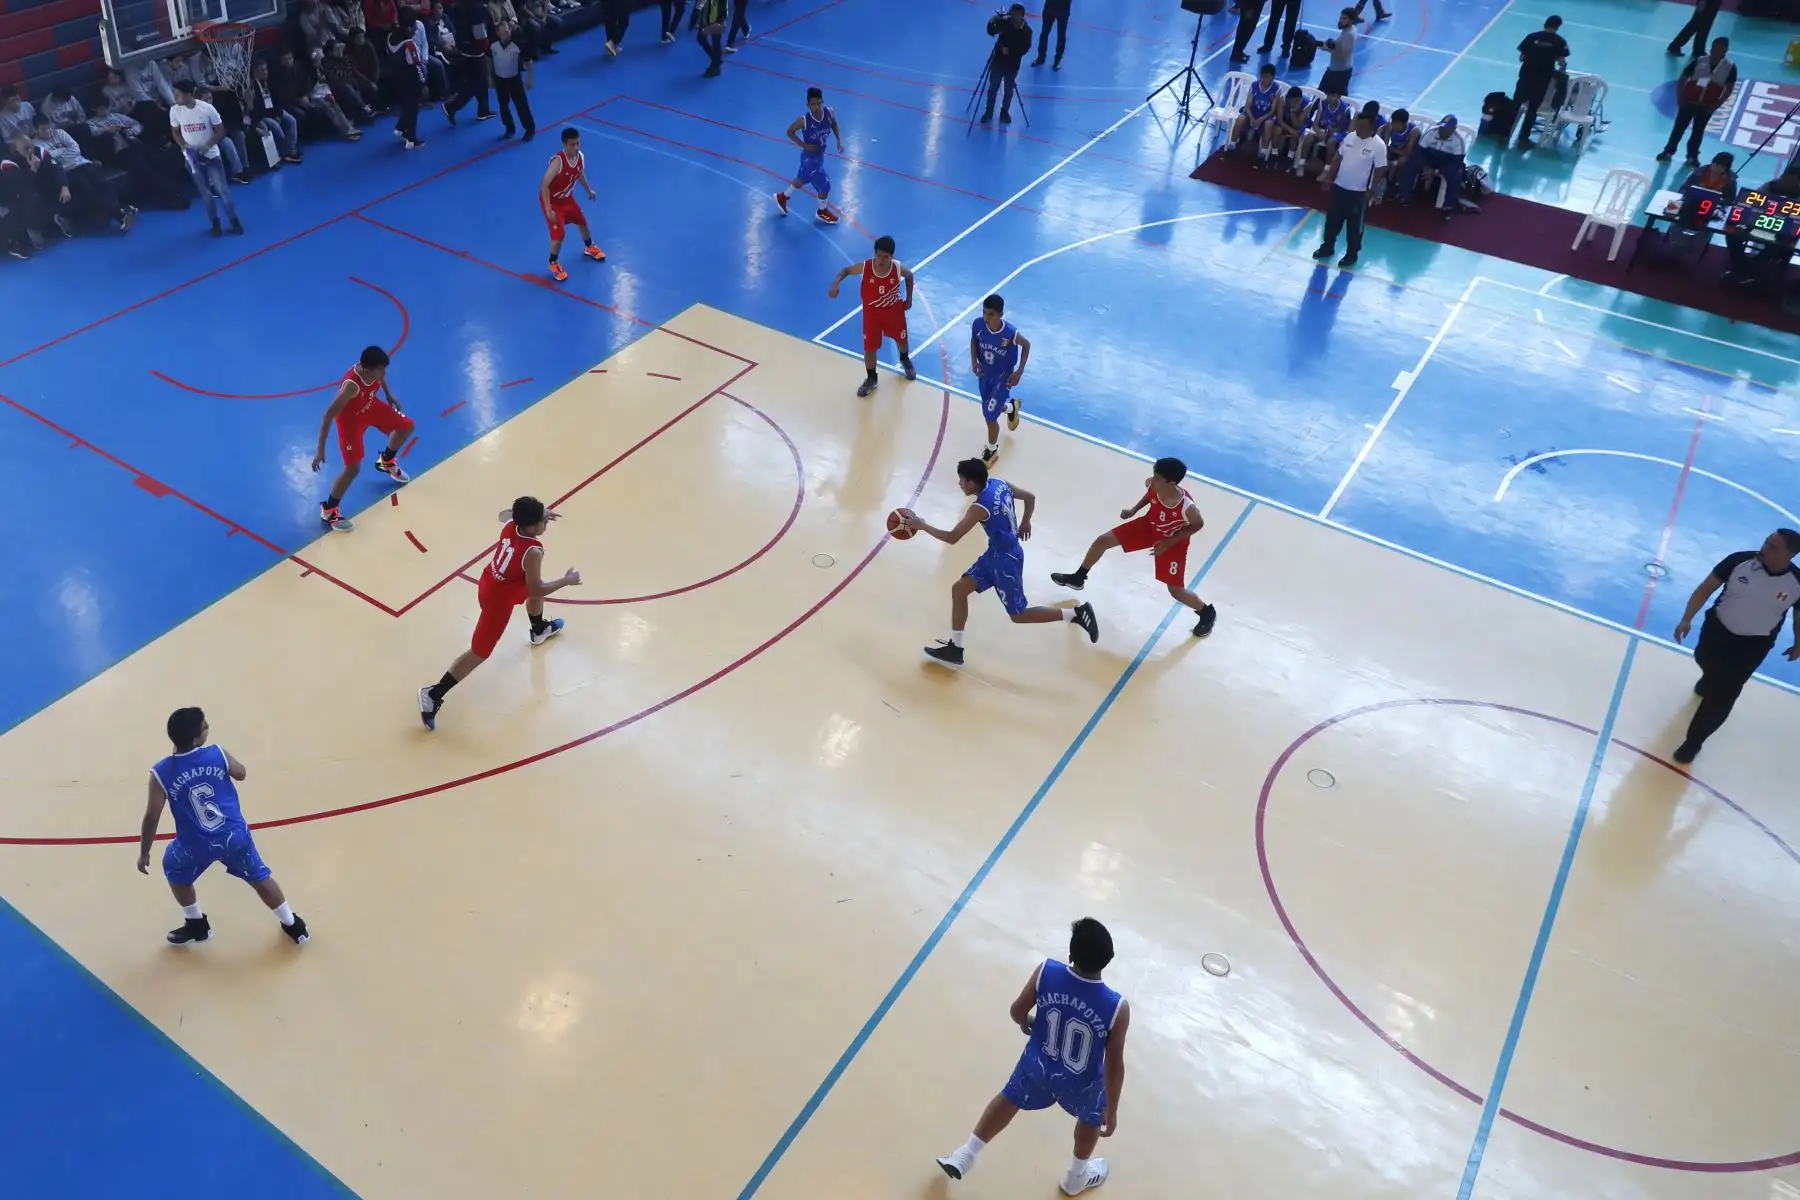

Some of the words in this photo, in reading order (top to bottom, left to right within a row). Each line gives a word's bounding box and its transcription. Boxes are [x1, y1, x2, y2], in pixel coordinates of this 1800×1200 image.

[1746, 192, 1767, 206] 24
[1698, 199, 1713, 215] 9
[1731, 207, 1744, 222] 5
[1765, 201, 1779, 215] 3
[1781, 201, 1800, 216] 23
[878, 285, 885, 295] 6
[900, 329, 907, 339] 6
[984, 350, 995, 366] 8
[987, 397, 998, 412] 8
[1159, 511, 1166, 522] 8
[496, 538, 515, 574] 11
[1169, 561, 1178, 575] 8
[169, 765, 226, 801] CHACHAPOYA
[188, 782, 226, 832] 6
[1041, 1007, 1094, 1075] 10
